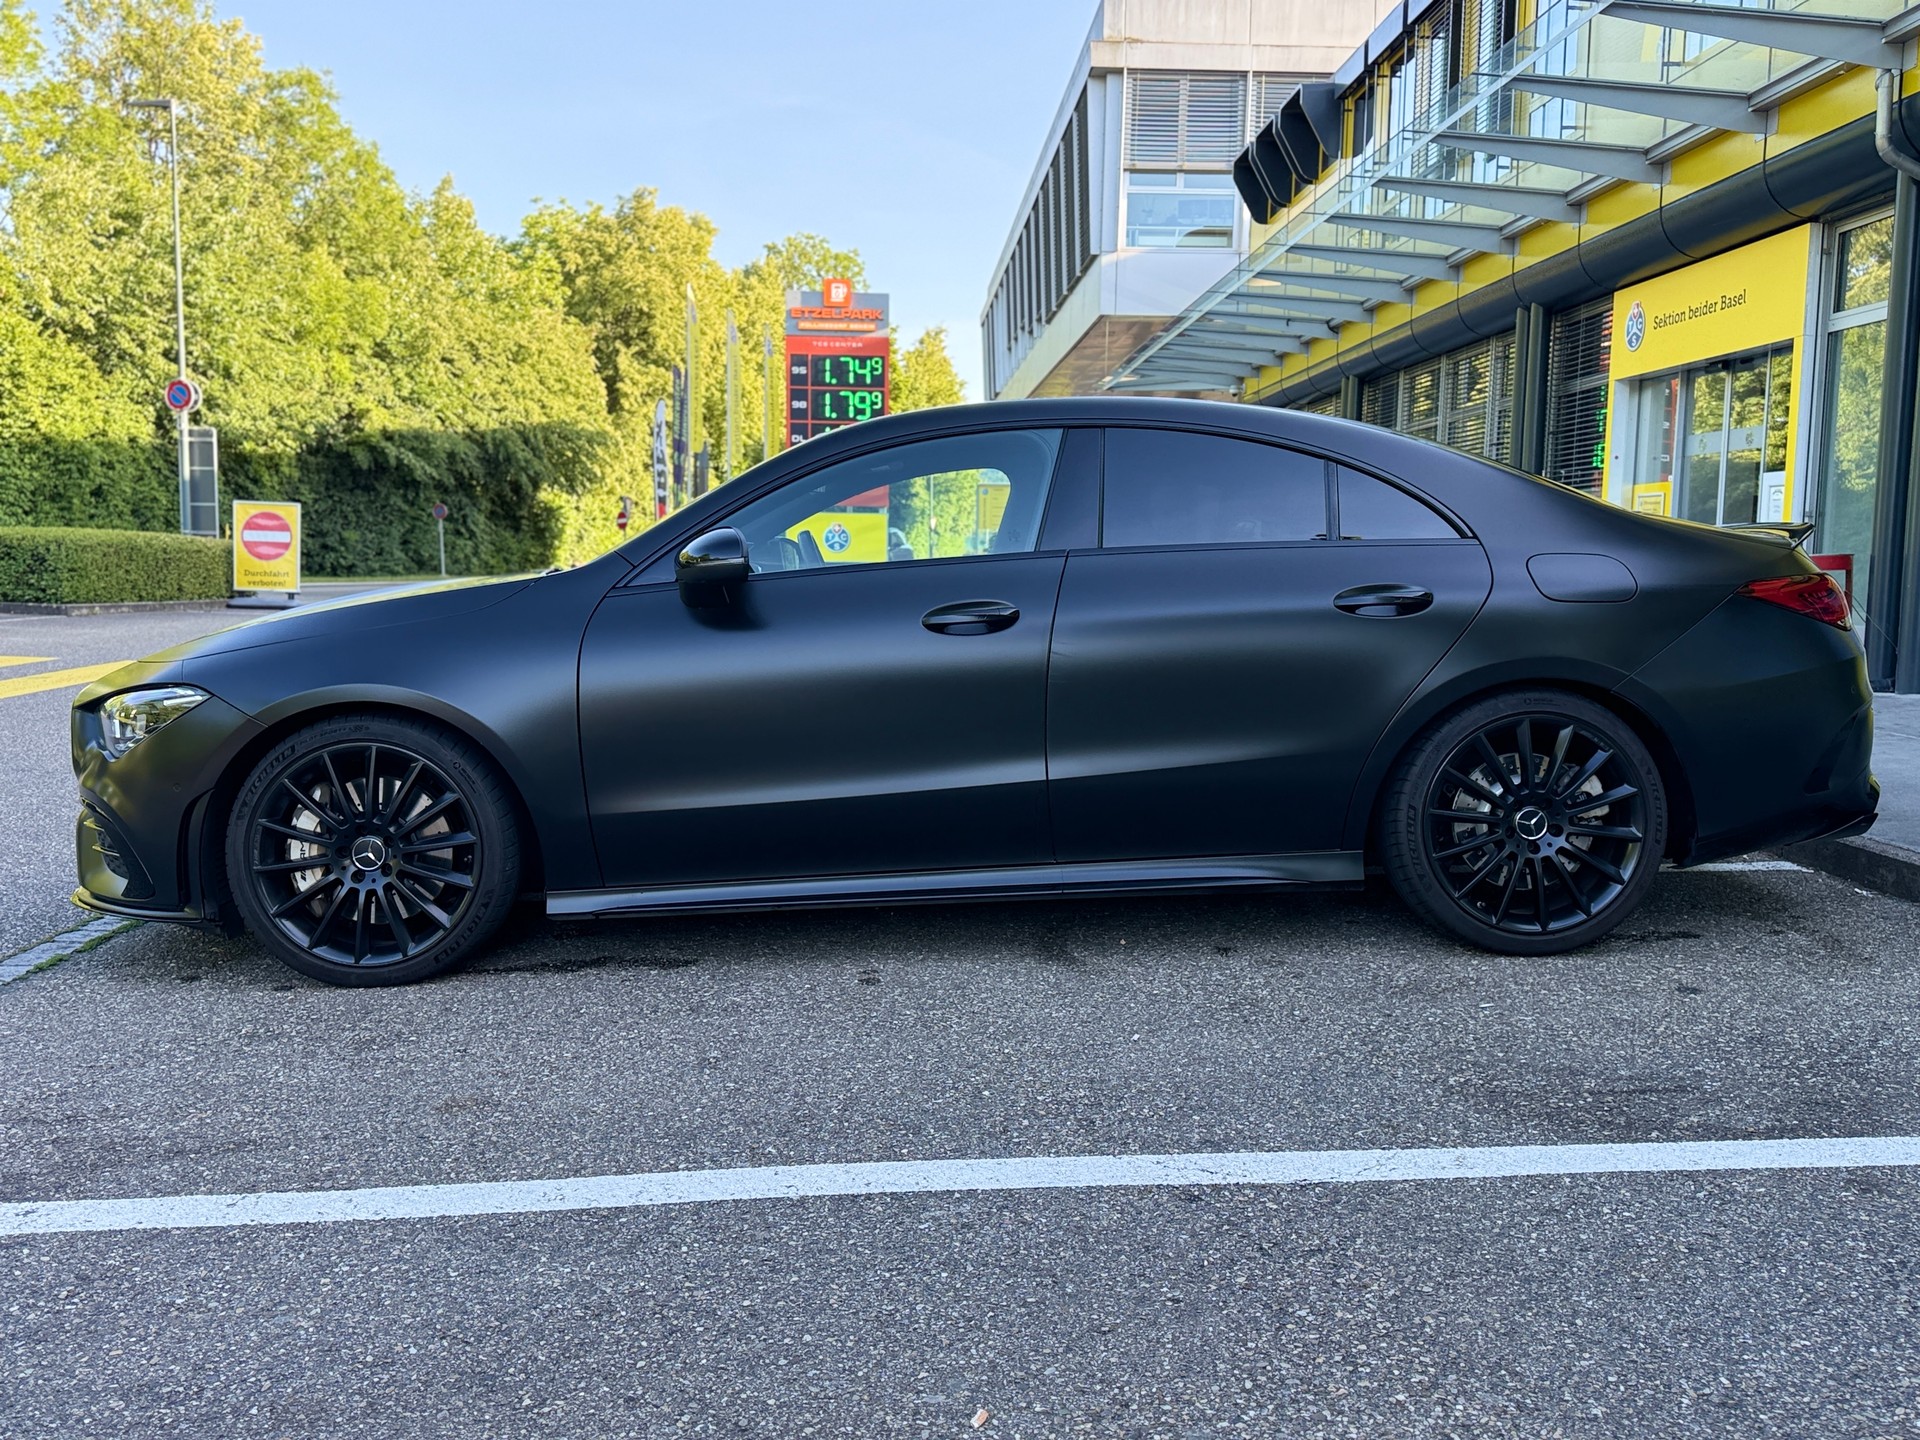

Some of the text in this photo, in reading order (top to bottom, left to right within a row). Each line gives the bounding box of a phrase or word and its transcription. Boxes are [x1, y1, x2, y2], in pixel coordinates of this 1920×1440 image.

[791, 307, 883, 320] ETZELPARK
[1653, 289, 1747, 330] Sektion beider Basel
[791, 366, 808, 375] 95
[791, 400, 808, 409] 98
[244, 569, 289, 577] Durchfahrt
[248, 579, 286, 587] verboten!
